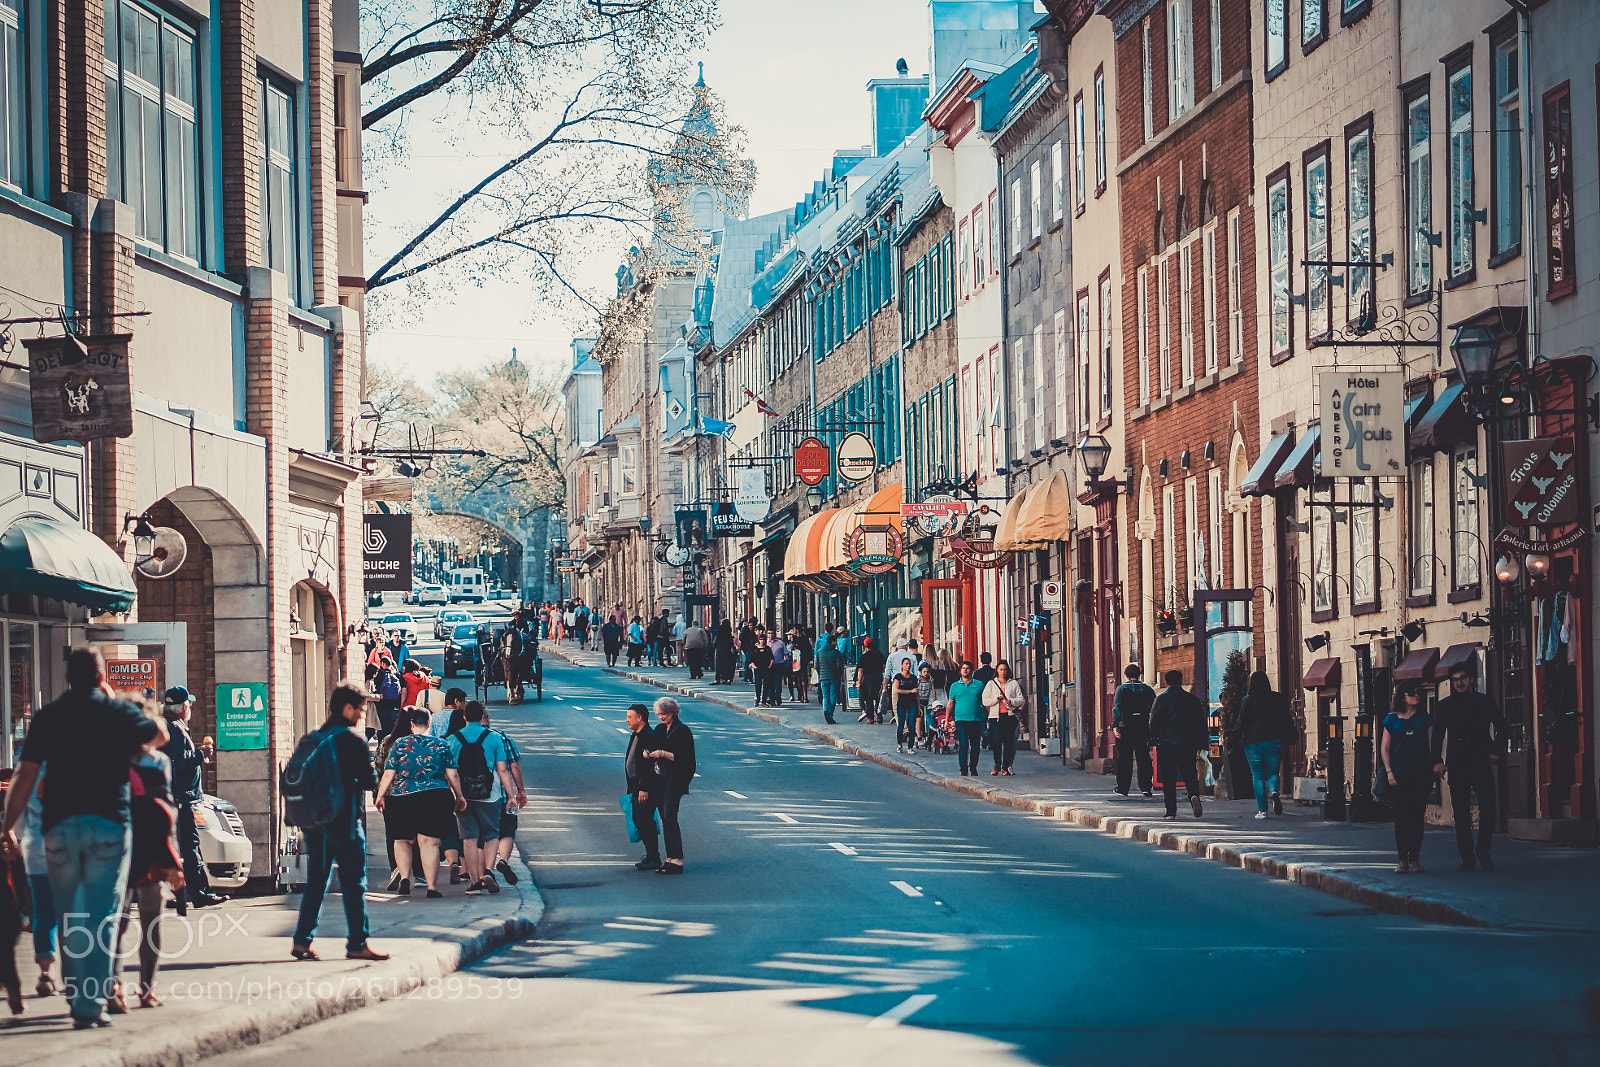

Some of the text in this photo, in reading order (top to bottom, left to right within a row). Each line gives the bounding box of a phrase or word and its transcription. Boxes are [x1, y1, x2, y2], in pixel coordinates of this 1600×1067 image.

[1347, 378, 1380, 389] Hôtel
[1332, 388, 1342, 468] AUBERGE
[1355, 420, 1392, 471] Louis
[807, 458, 827, 467] PARIS
[1387, 458, 1400, 471] 48
[1510, 452, 1539, 483] Trois
[1537, 474, 1575, 523] Colombes
[713, 514, 728, 525] FEU
[1500, 534, 1530, 550] galerie
[958, 551, 966, 560] LA
[965, 558, 985, 568] PORTE
[110, 662, 152, 674] COMBO
